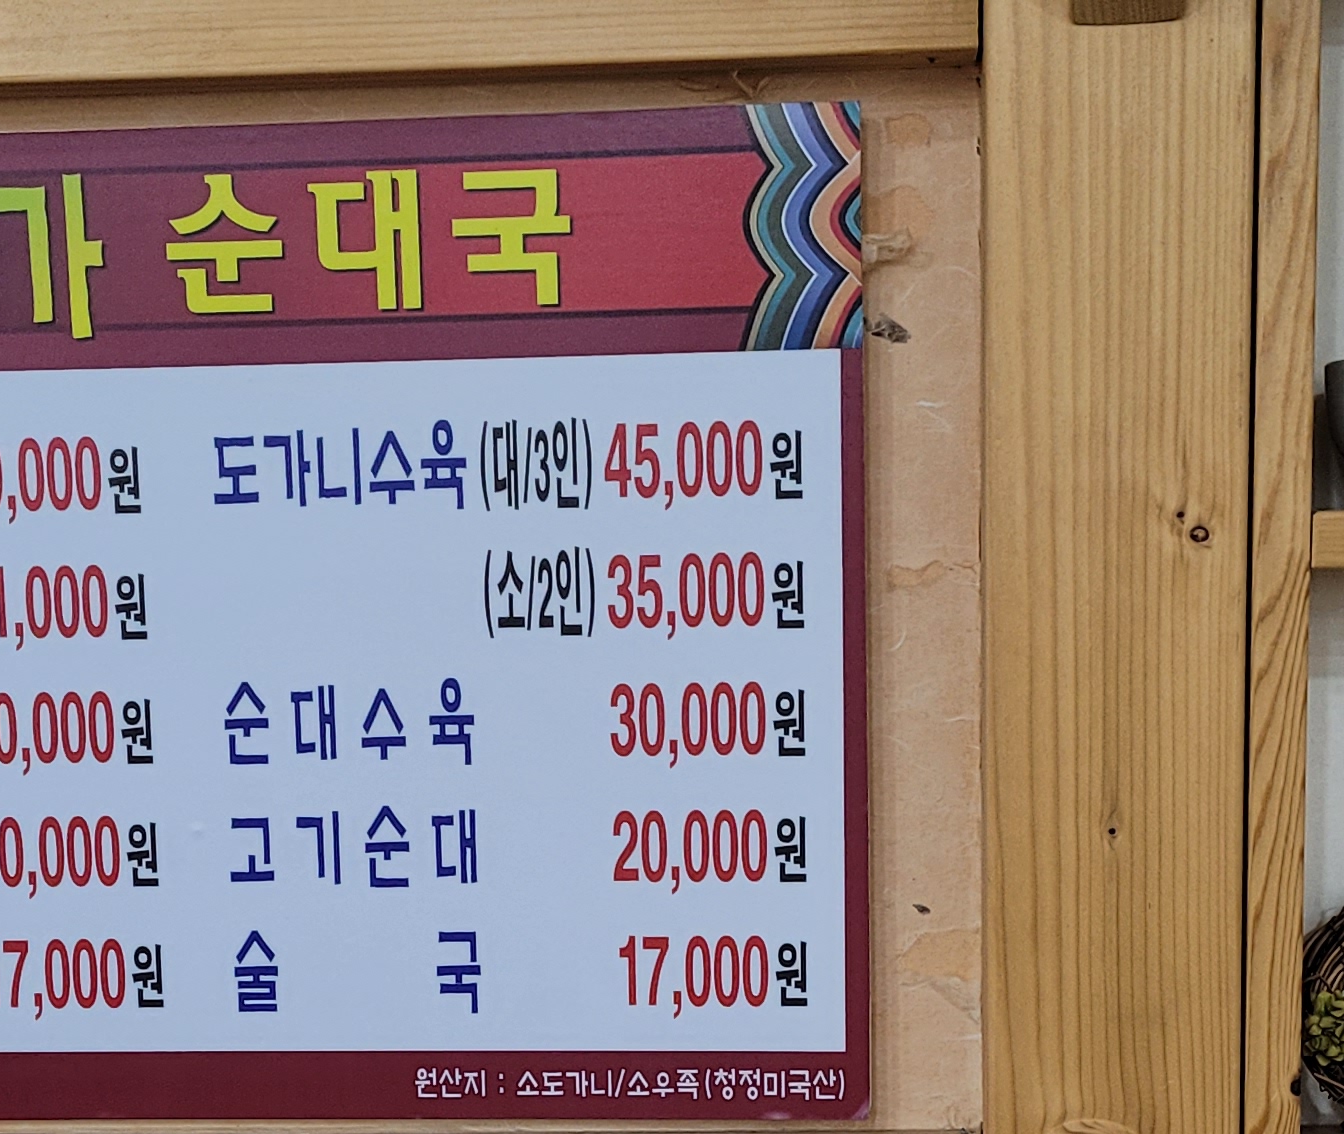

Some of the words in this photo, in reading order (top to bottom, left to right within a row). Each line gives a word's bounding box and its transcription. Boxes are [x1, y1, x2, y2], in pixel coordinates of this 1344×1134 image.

[166, 169, 571, 314] 순대국
[214, 420, 467, 509] 도가니수육
[605, 420, 803, 510] 45,000원
[484, 546, 595, 638] (소/2인)
[608, 552, 804, 640] 35,000원
[611, 681, 805, 768] 30,000원
[613, 809, 807, 894] 20,000원
[619, 935, 808, 1019] 17,000원
[414, 1068, 486, 1098] 원산지
